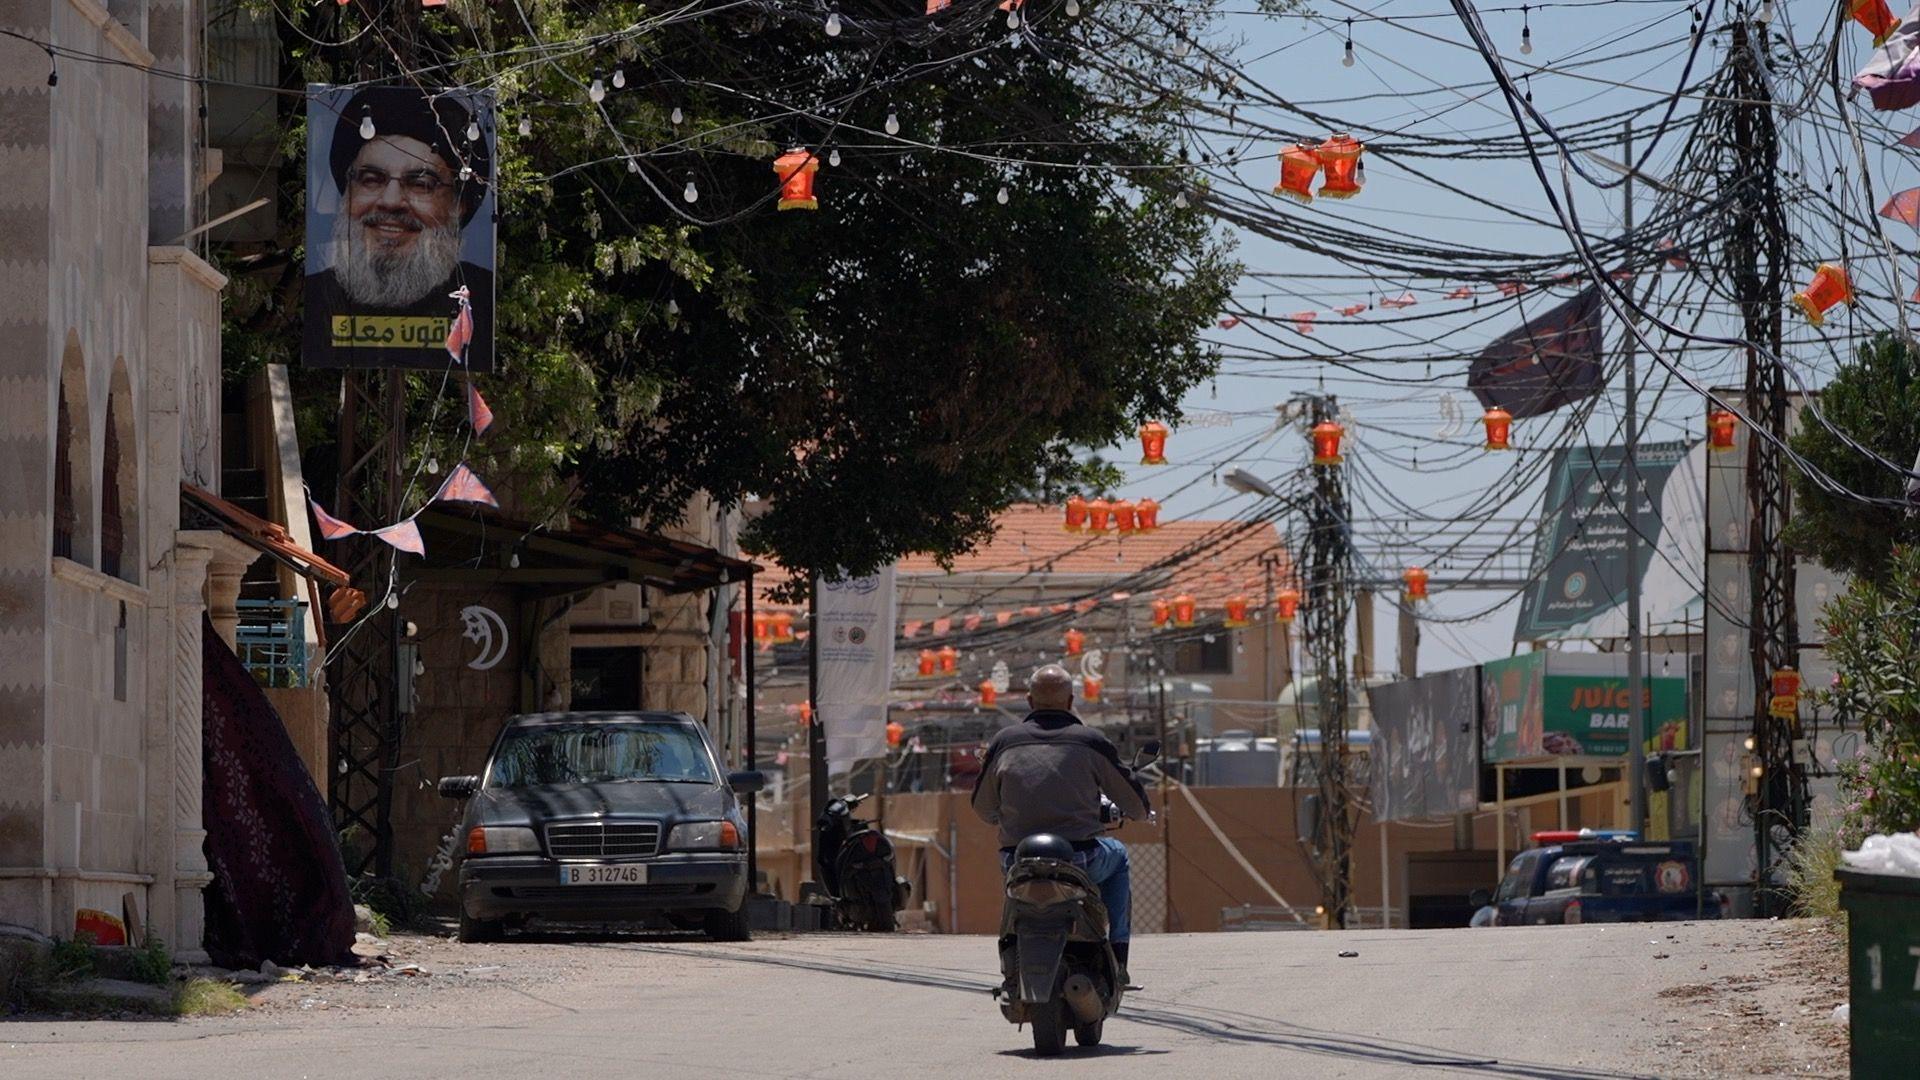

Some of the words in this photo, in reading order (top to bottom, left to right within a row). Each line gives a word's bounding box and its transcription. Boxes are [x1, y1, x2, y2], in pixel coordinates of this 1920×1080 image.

[1590, 713, 1631, 728] BAR
[571, 868, 580, 883] B
[588, 867, 638, 883] 312746
